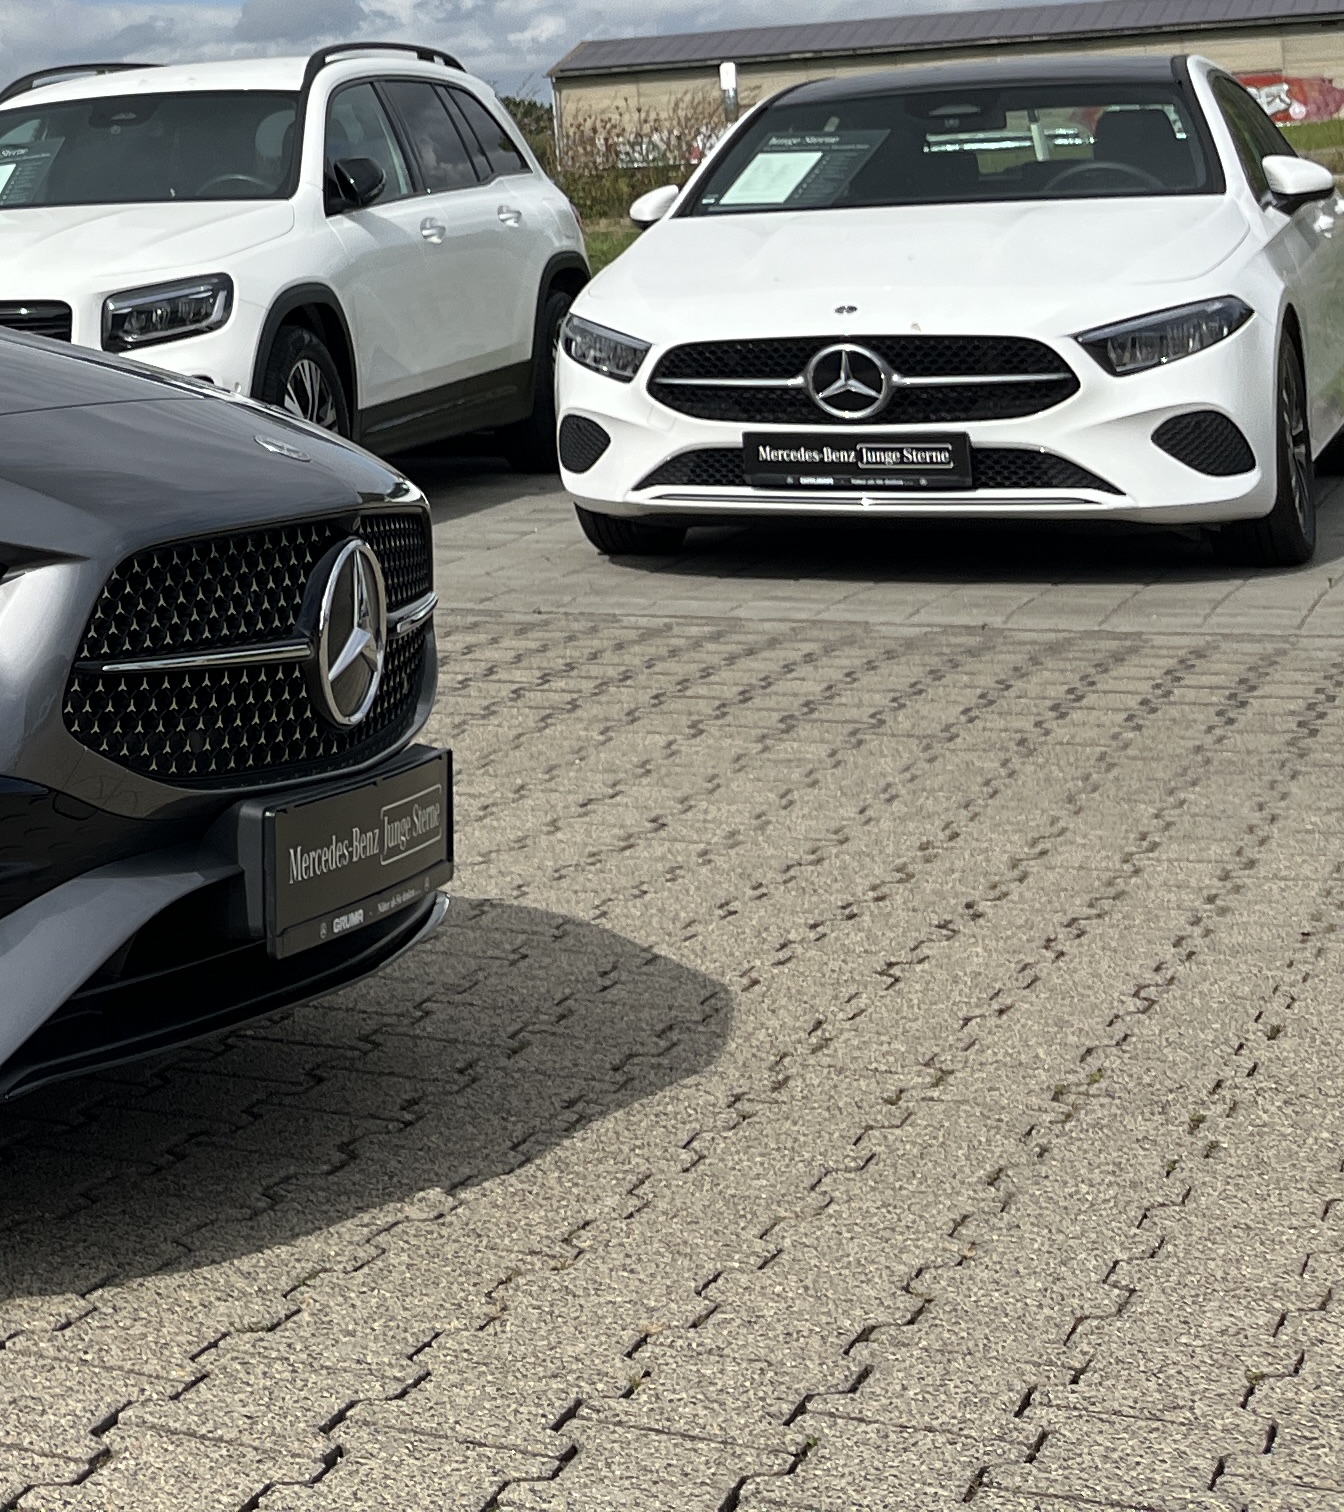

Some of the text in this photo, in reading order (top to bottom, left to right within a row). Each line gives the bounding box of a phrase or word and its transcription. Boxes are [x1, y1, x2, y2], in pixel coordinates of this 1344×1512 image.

[758, 445, 950, 465] Mercedes-Benz Junge Sterne
[289, 801, 441, 884] Mercedes-Benz Junge Sterne
